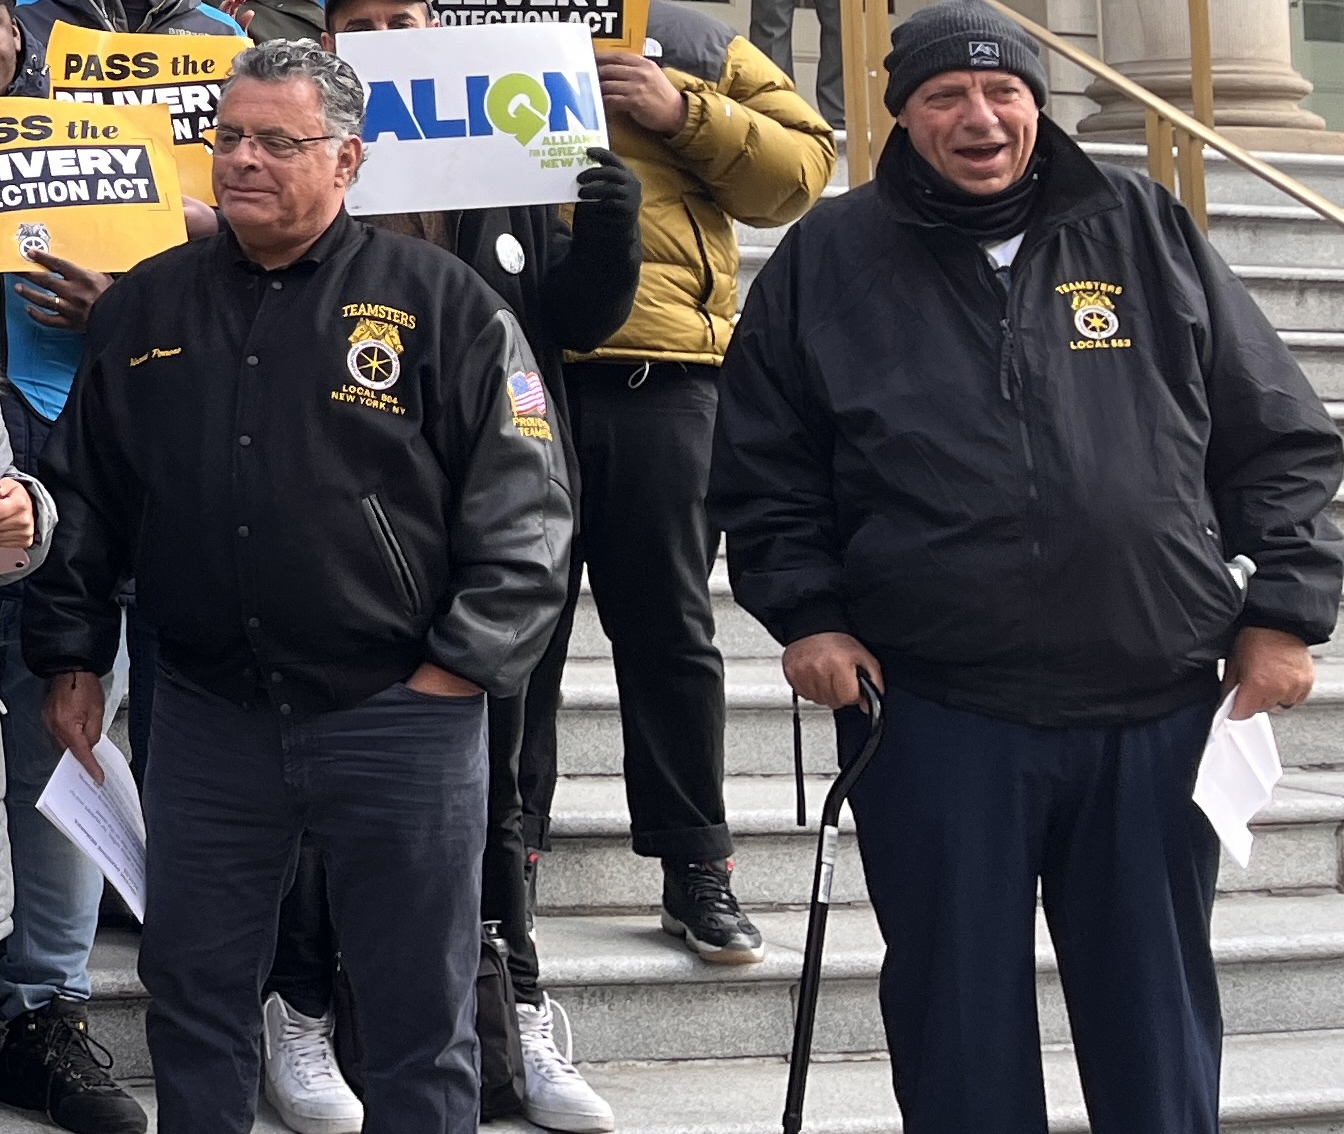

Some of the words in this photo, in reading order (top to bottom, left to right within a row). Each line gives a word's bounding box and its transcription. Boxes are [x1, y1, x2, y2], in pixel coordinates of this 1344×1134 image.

[64, 51, 160, 81] PASS
[169, 54, 216, 76] the
[362, 71, 600, 147] ALIGN
[65, 119, 119, 140] the
[96, 177, 150, 201] ACT
[342, 303, 416, 330] TEAMSTERS
[1070, 338, 1109, 350] LOCAL
[331, 391, 356, 403] NEW
[392, 405, 406, 415] NY
[342, 384, 378, 399] LOCAL
